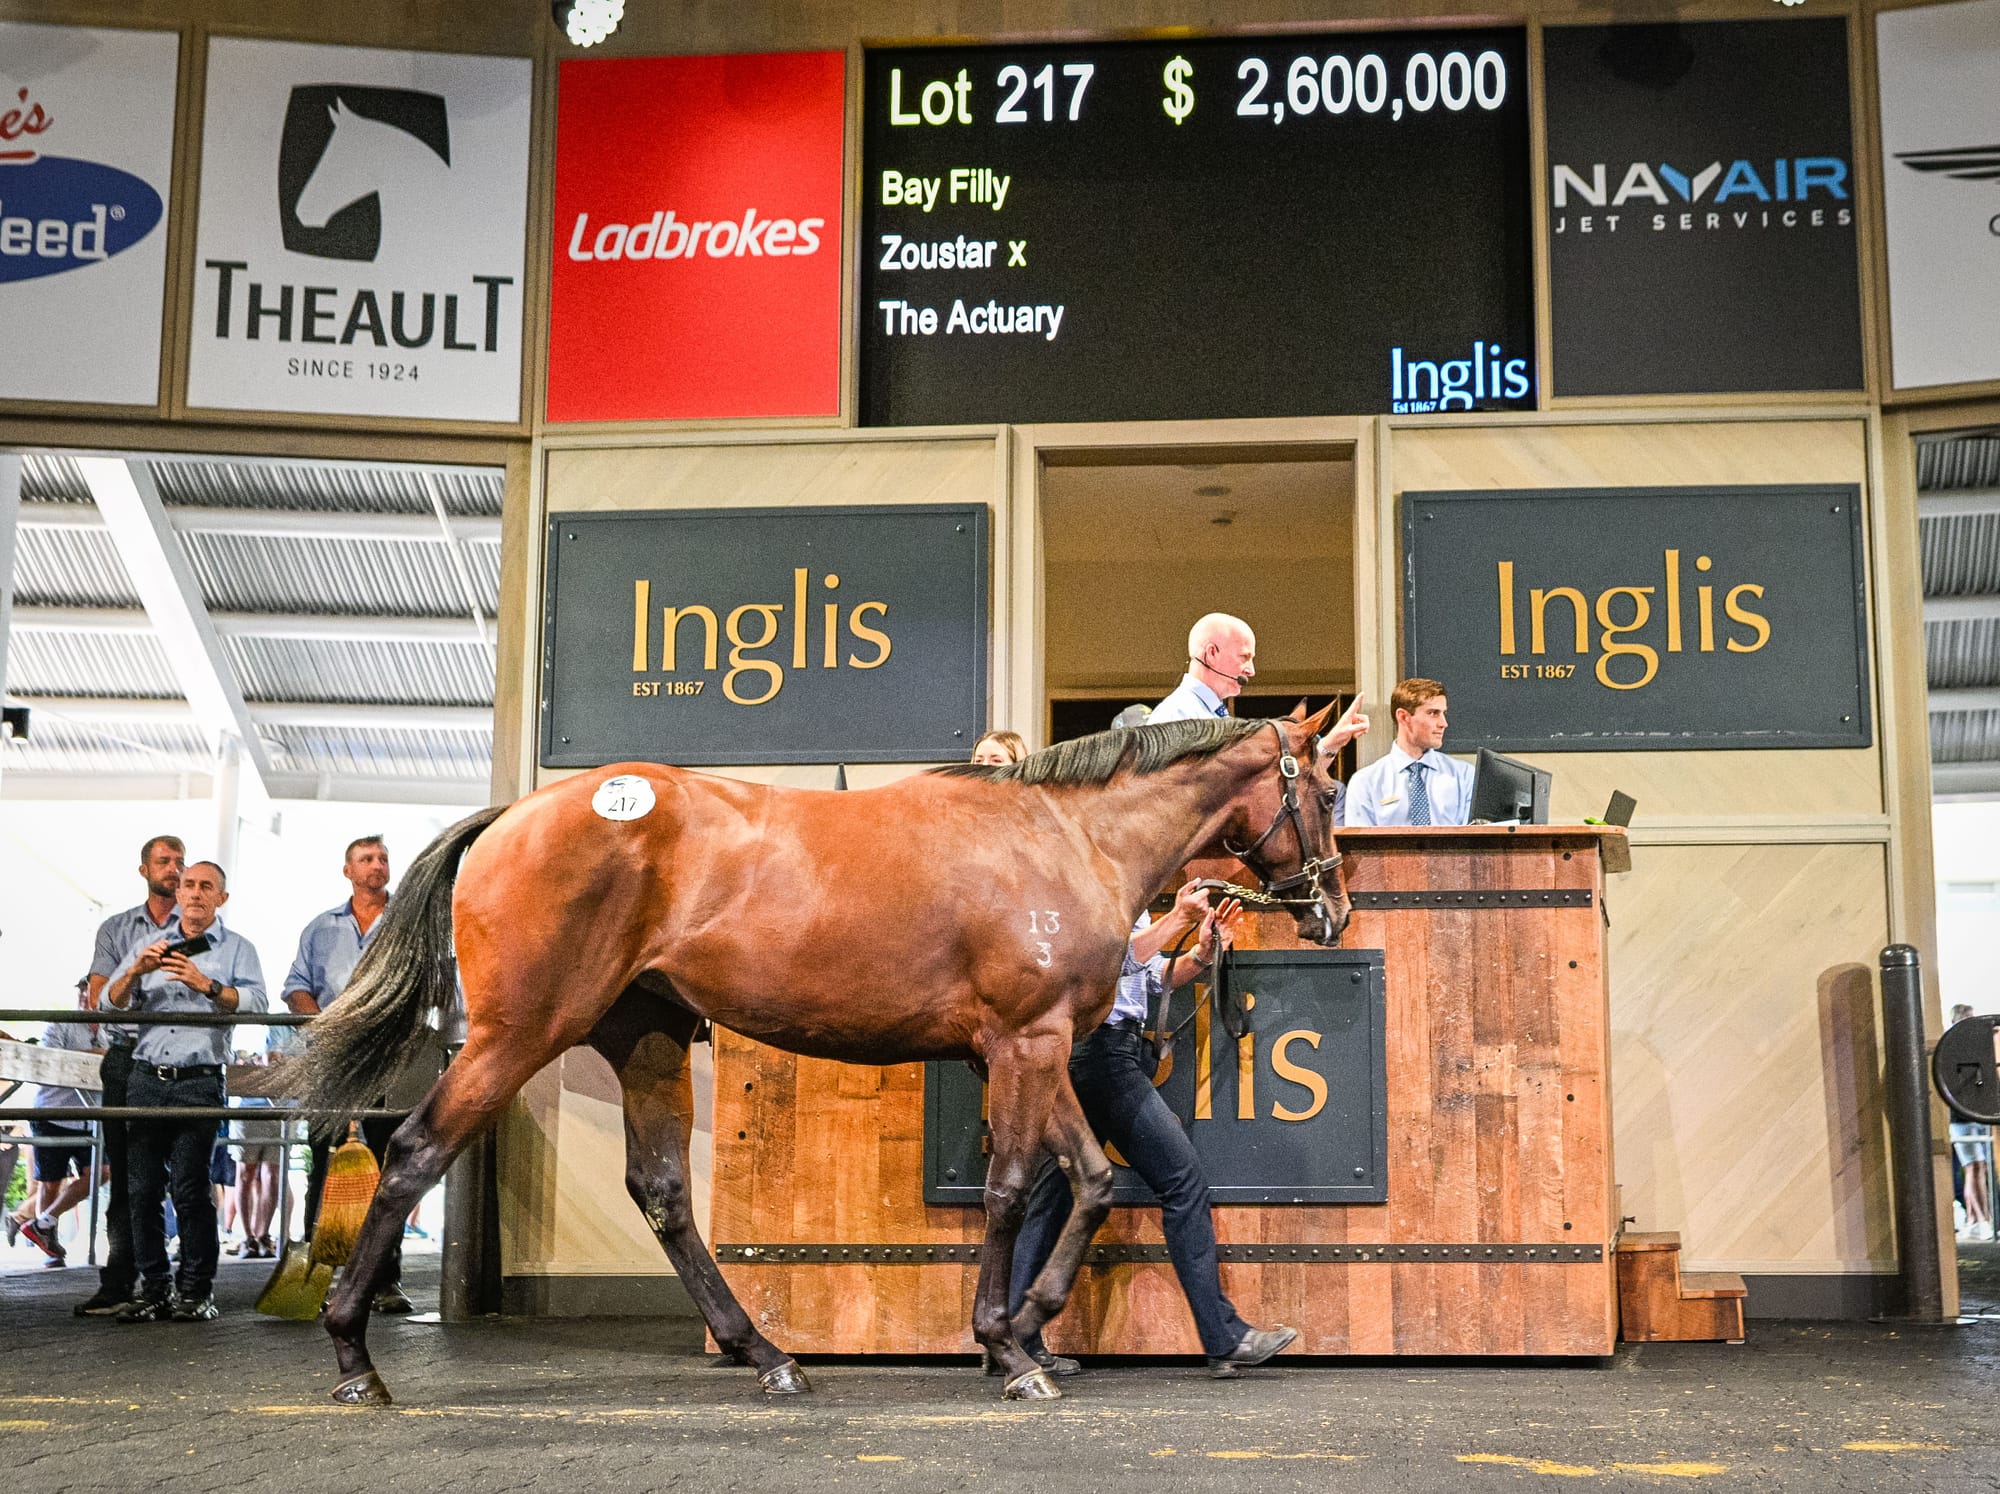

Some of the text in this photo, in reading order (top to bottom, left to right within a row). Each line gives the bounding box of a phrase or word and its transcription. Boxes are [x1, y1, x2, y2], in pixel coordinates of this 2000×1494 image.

[890, 50, 1507, 126] Lot 217 $ 2,600,000
[881, 167, 1010, 212] Bay Filly
[1553, 157, 1849, 207] NAVAIR
[568, 208, 825, 262] Ladbrokes
[1555, 208, 1852, 233] JET SERVICES
[880, 234, 1027, 271] Zoustar x
[879, 299, 1064, 341] The Actuary
[287, 358, 420, 381] SINCE 1924
[1391, 340, 1530, 411] Inglis
[1410, 400, 1438, 413] 1867
[632, 567, 892, 706] Inglis
[1498, 548, 1771, 690] Inglis
[632, 681, 705, 697] EST 1867
[1500, 664, 1577, 679] EST 1867
[607, 796, 638, 812] 217
[1028, 910, 1061, 935] 13
[1036, 942, 1052, 968] 3
